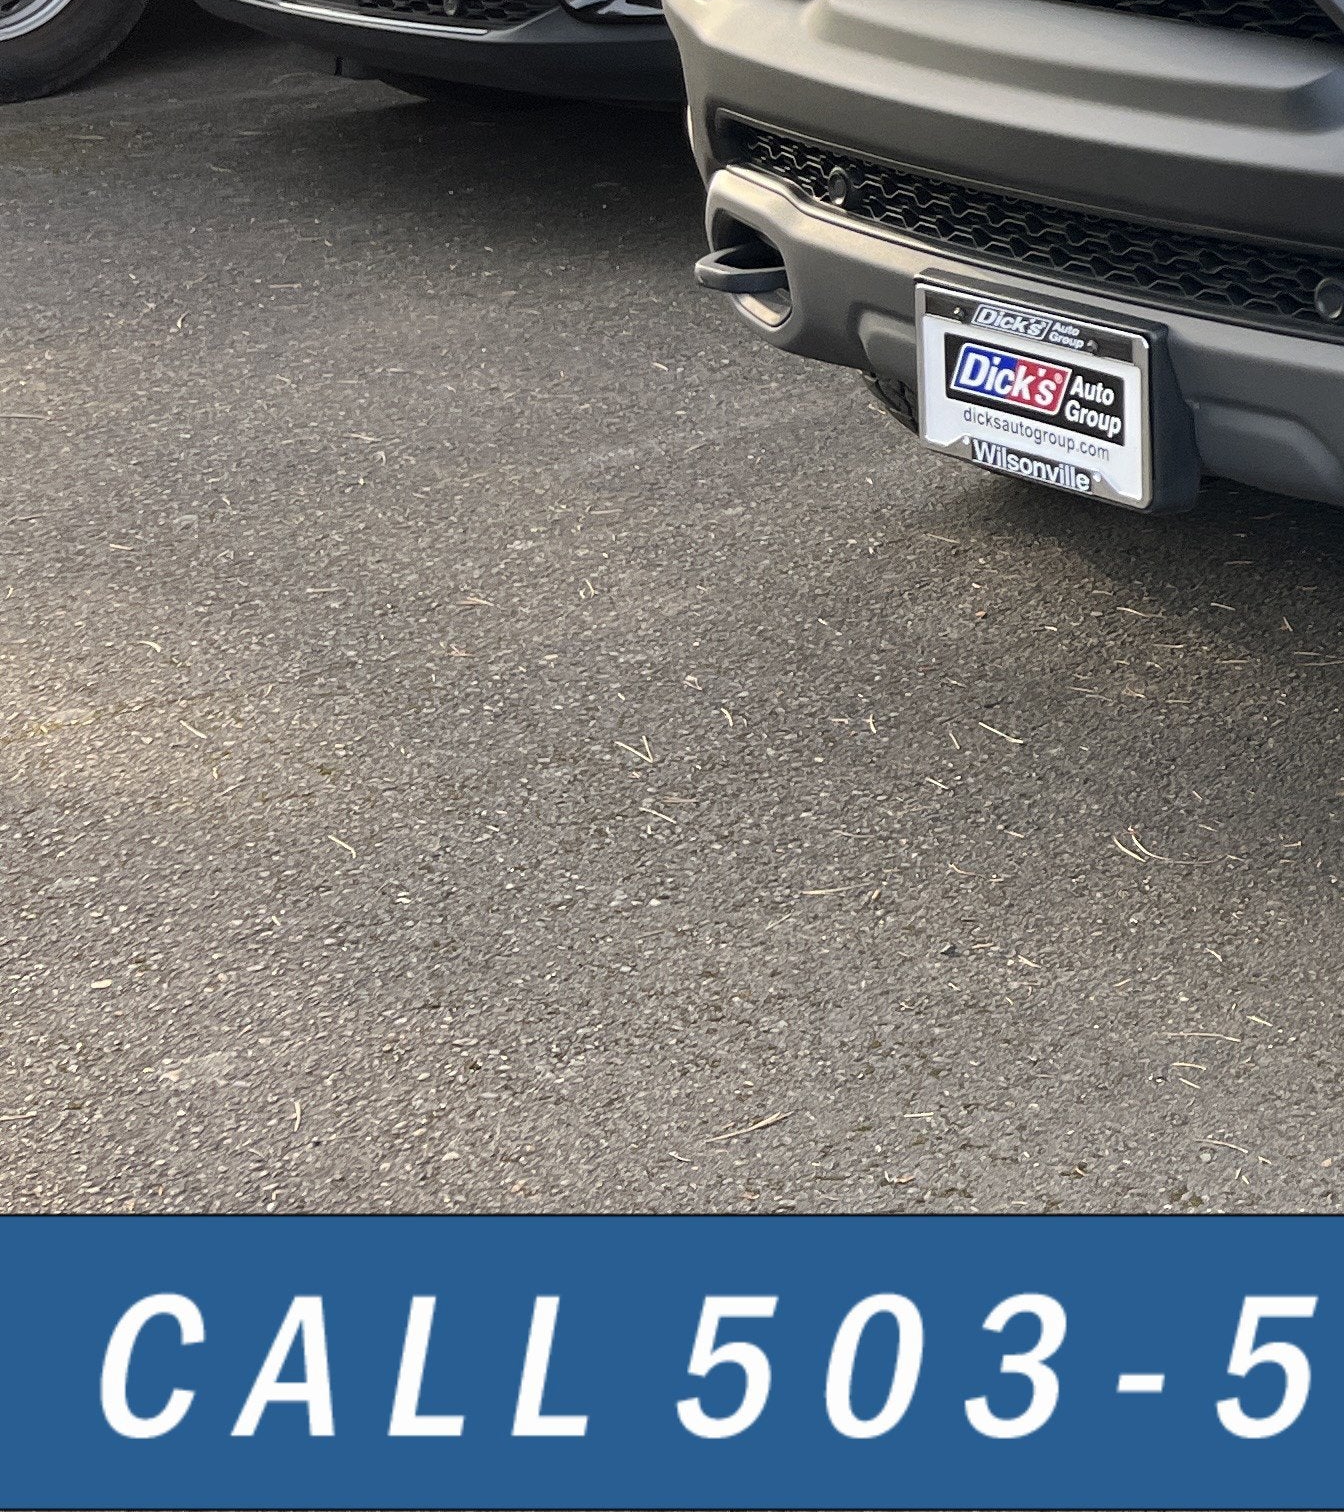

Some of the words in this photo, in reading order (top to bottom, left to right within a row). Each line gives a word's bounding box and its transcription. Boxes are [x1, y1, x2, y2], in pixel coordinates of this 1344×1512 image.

[977, 308, 1043, 336] Dick's
[1051, 321, 1081, 336] Auto
[1048, 331, 1085, 349] Group
[958, 351, 1058, 407] Dick's
[1069, 374, 1115, 406] Auto
[962, 405, 1110, 462] dicksautogroup.com
[1064, 399, 1123, 438] Group
[972, 439, 1091, 492] Wilsonville
